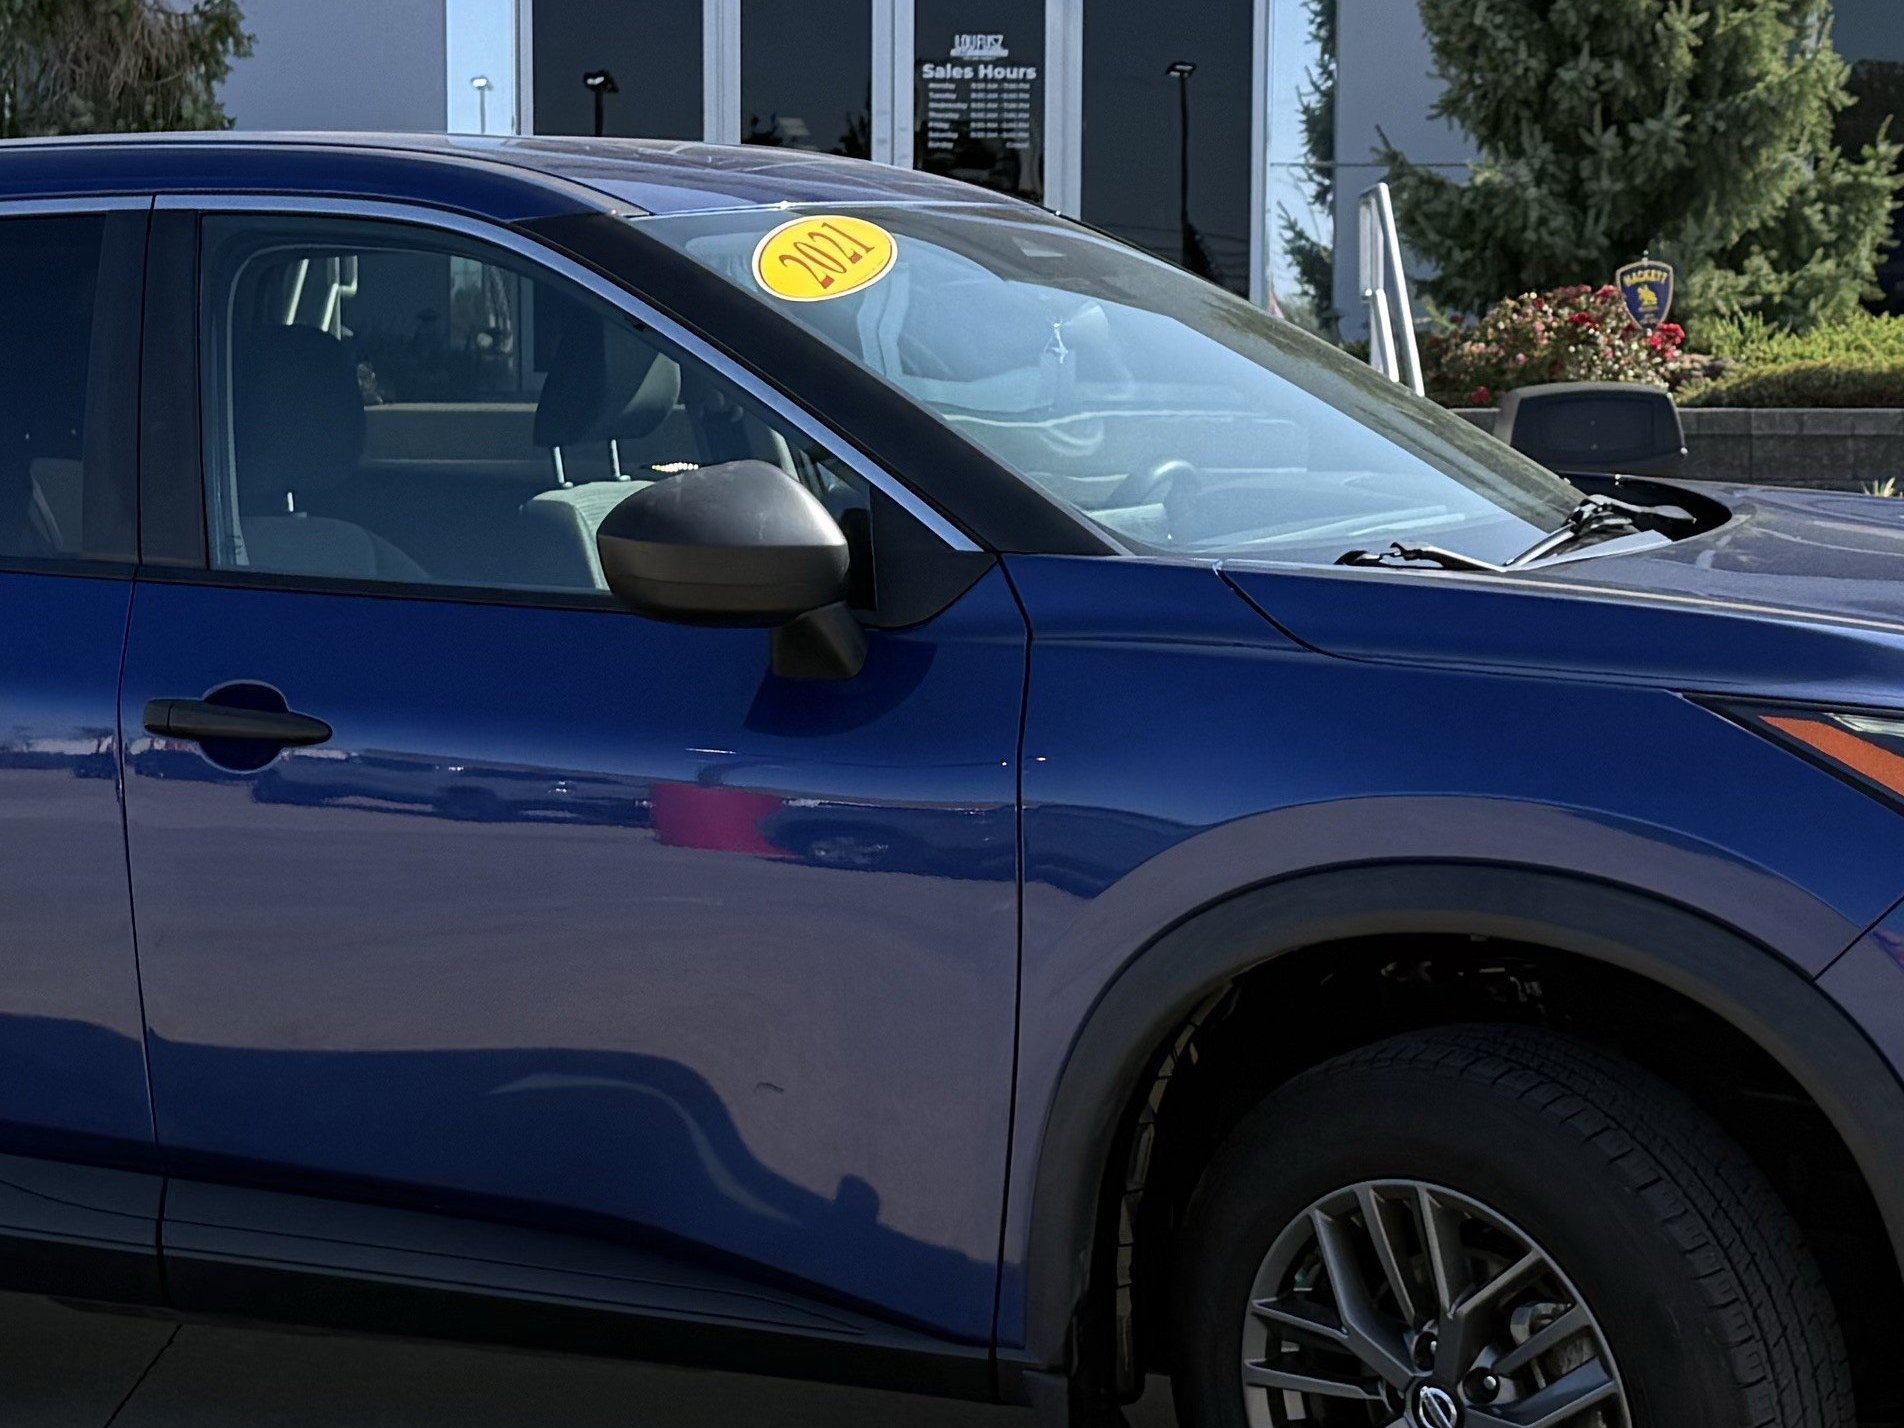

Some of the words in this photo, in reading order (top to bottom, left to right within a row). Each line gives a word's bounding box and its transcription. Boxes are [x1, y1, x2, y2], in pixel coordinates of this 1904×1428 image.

[922, 63, 974, 79] Sales
[978, 64, 1037, 79] Hours
[779, 222, 875, 289] 2021
